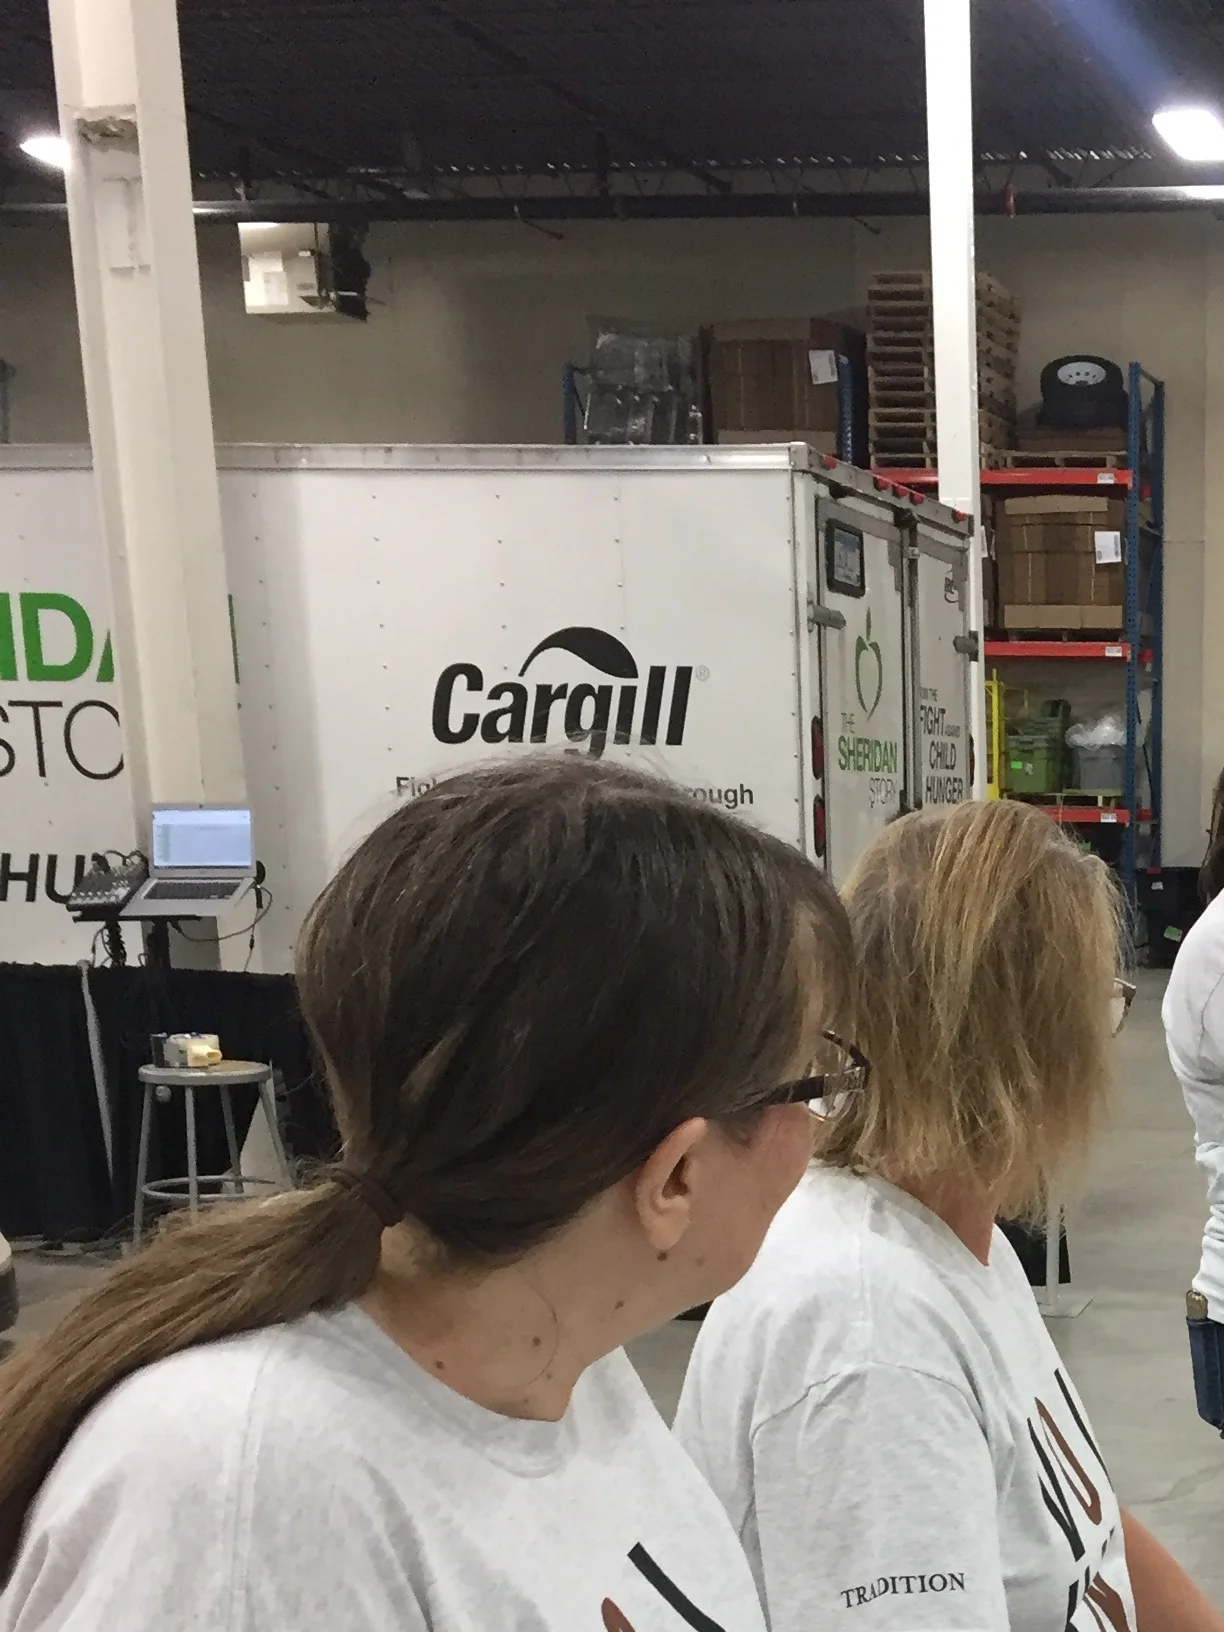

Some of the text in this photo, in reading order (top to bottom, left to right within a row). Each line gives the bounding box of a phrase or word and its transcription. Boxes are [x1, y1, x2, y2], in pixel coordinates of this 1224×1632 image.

[432, 662, 693, 760] Cargill
[841, 712, 856, 734] THE
[920, 704, 946, 736] FIGHT
[838, 735, 898, 774] SHERIDAN
[929, 740, 957, 771] CHILD
[925, 776, 964, 805] HUNGER
[840, 1572, 965, 1609] TRADITION
